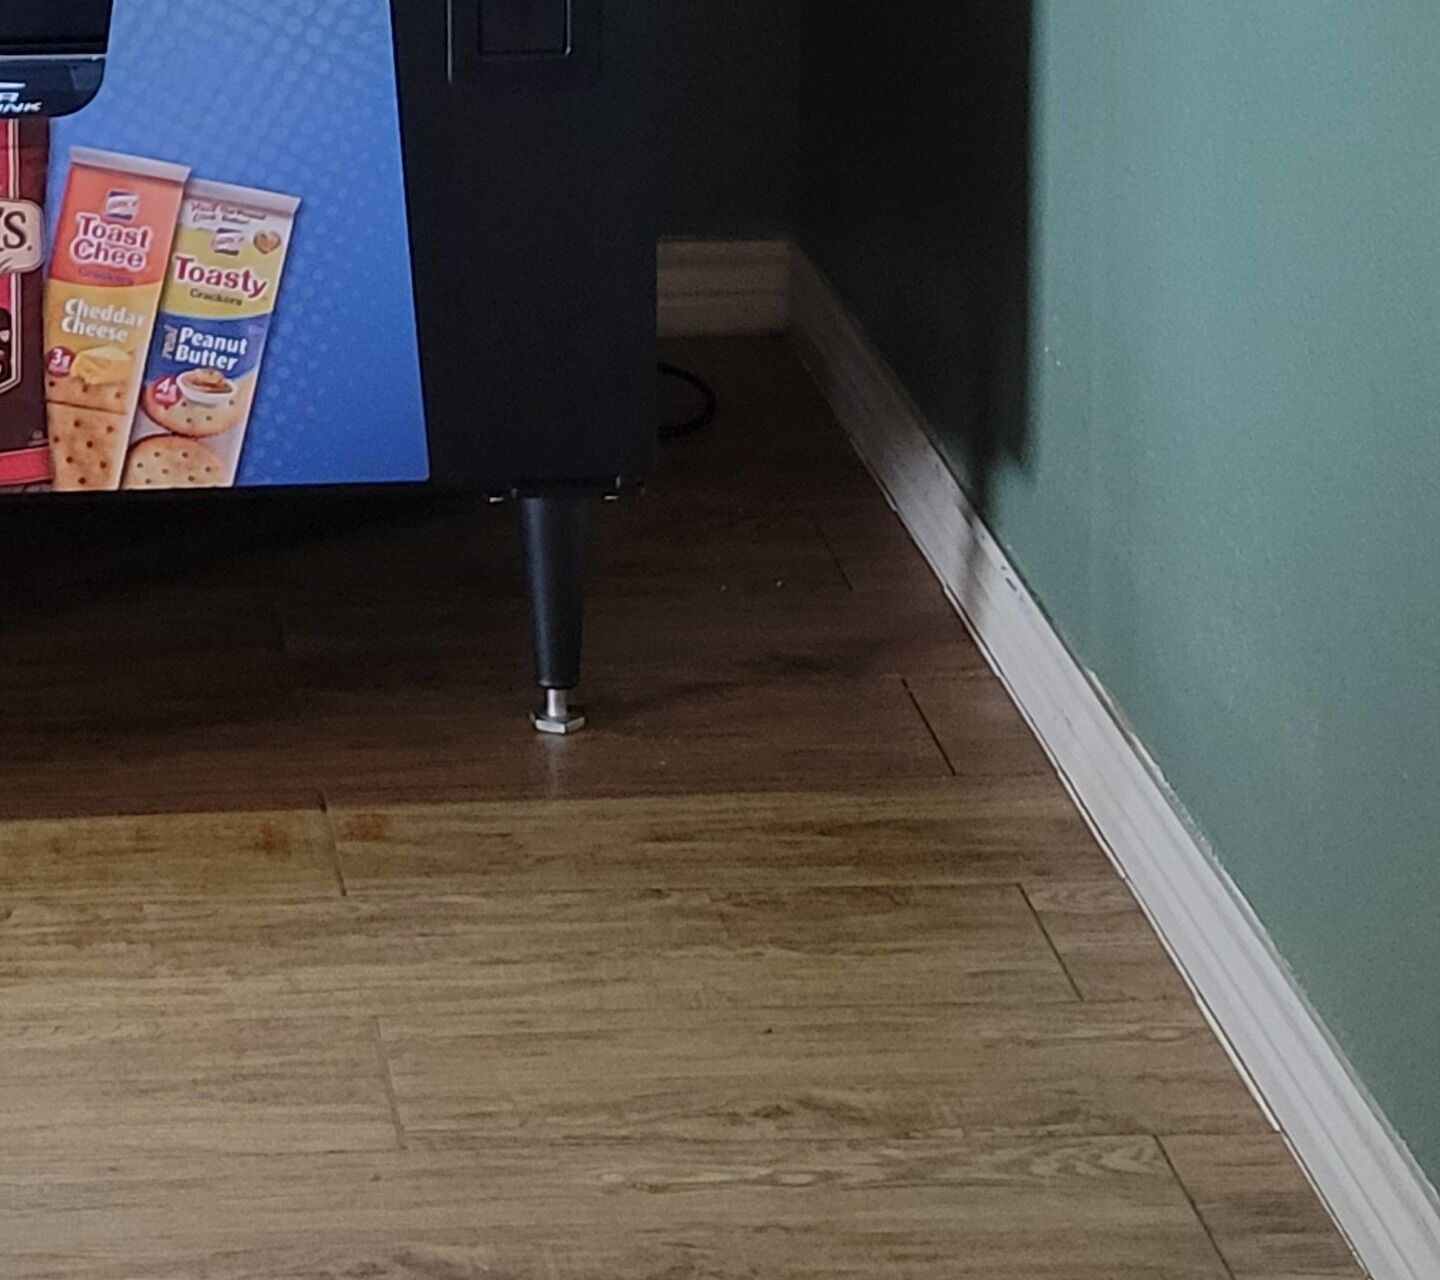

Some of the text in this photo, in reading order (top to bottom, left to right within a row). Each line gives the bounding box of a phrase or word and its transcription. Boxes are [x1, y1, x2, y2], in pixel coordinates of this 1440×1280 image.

[79, 215, 149, 248] Toast
[73, 238, 143, 268] Chee
[174, 255, 268, 299] Toasty
[64, 298, 147, 328] Cheddar
[61, 316, 129, 342] Cheese
[179, 326, 248, 355] Peanut
[174, 344, 239, 371] Butter
